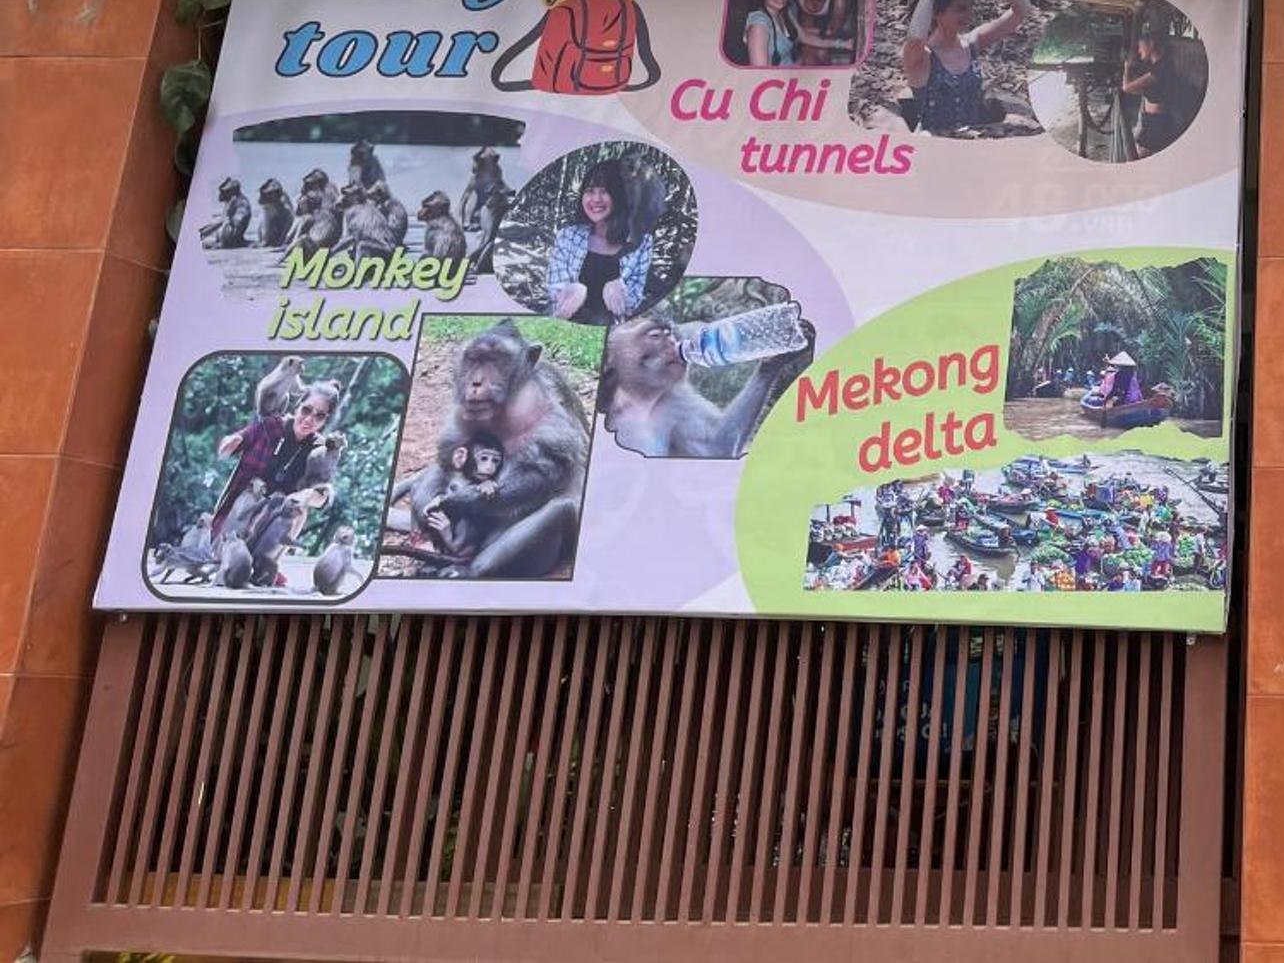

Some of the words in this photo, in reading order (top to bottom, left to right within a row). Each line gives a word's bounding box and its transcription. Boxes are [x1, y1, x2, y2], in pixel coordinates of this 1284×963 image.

[275, 20, 499, 79] tour
[670, 78, 732, 122] Cu
[749, 78, 828, 122] Chi
[740, 134, 914, 175] tunnels
[278, 247, 470, 300] Monkey
[267, 298, 421, 342] island
[796, 344, 1001, 421] Mekong
[859, 411, 997, 473] delta
